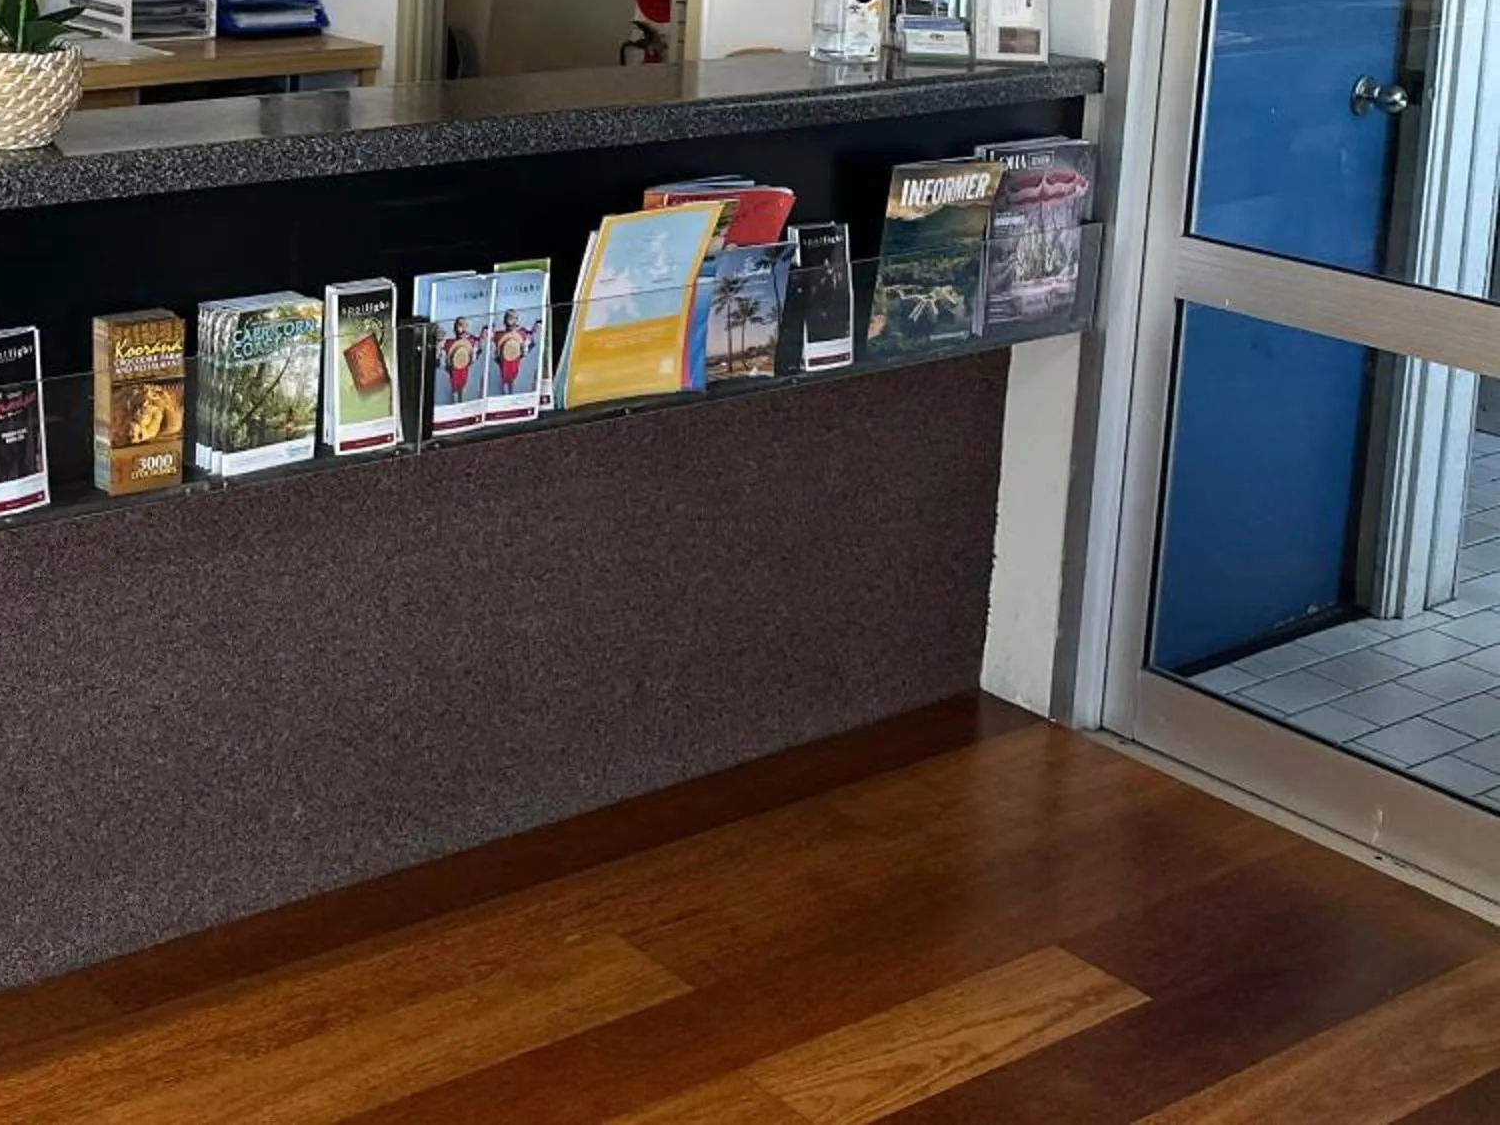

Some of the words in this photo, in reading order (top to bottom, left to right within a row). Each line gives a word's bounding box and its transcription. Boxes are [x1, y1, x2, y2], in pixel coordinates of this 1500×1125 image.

[901, 173, 991, 207] INFORMER
[233, 319, 315, 344] CAPRICORN
[138, 454, 174, 472] 3000
